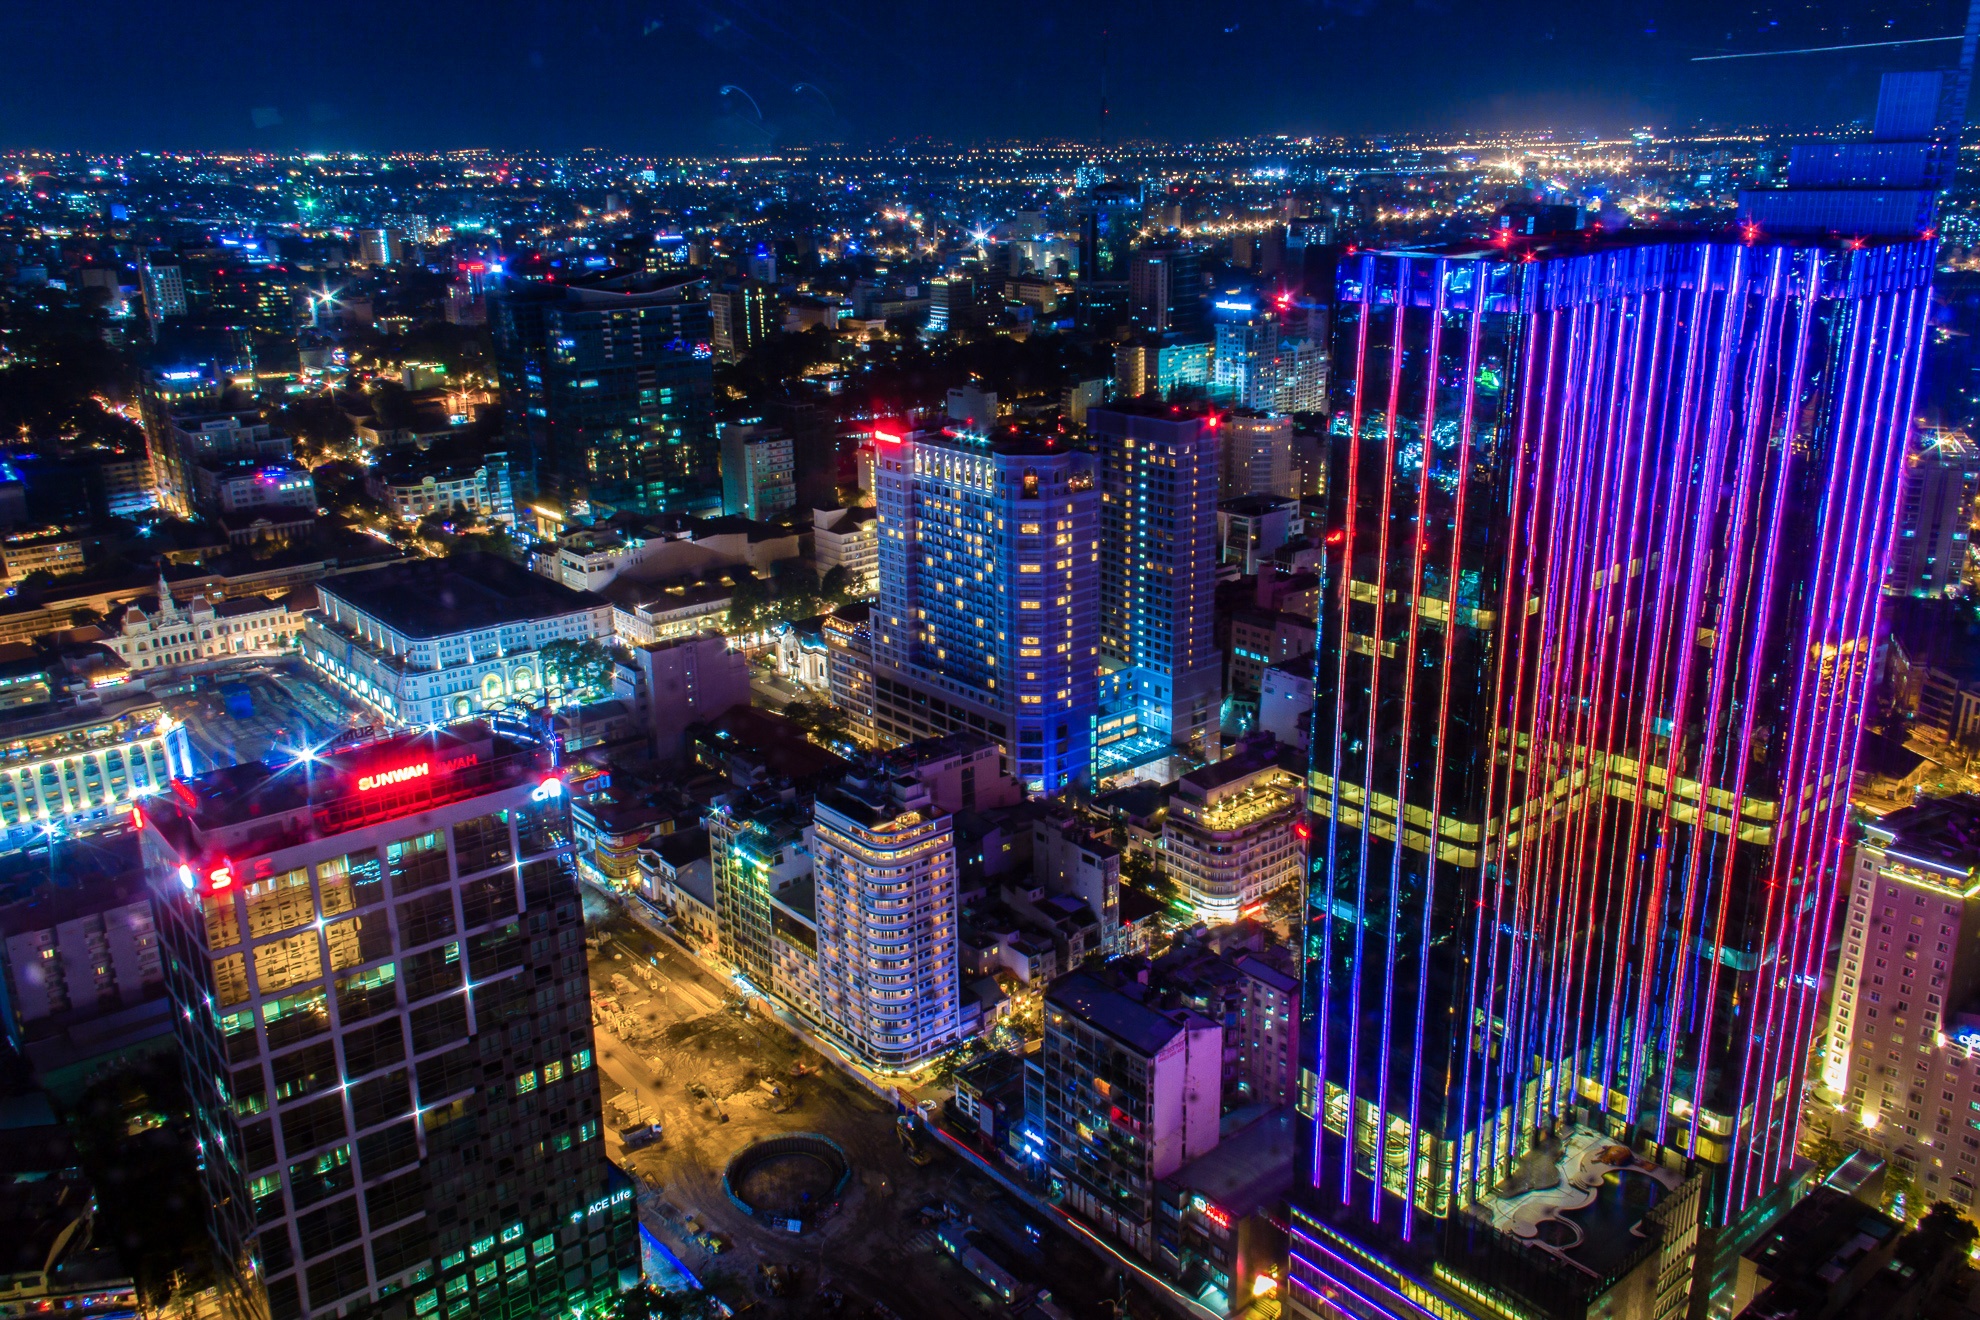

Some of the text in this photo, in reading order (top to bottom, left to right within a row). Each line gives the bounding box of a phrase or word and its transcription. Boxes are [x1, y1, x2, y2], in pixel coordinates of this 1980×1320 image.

[358, 762, 429, 791] SUNWAH
[583, 775, 611, 792] citi
[587, 1189, 632, 1216] ACE Life
